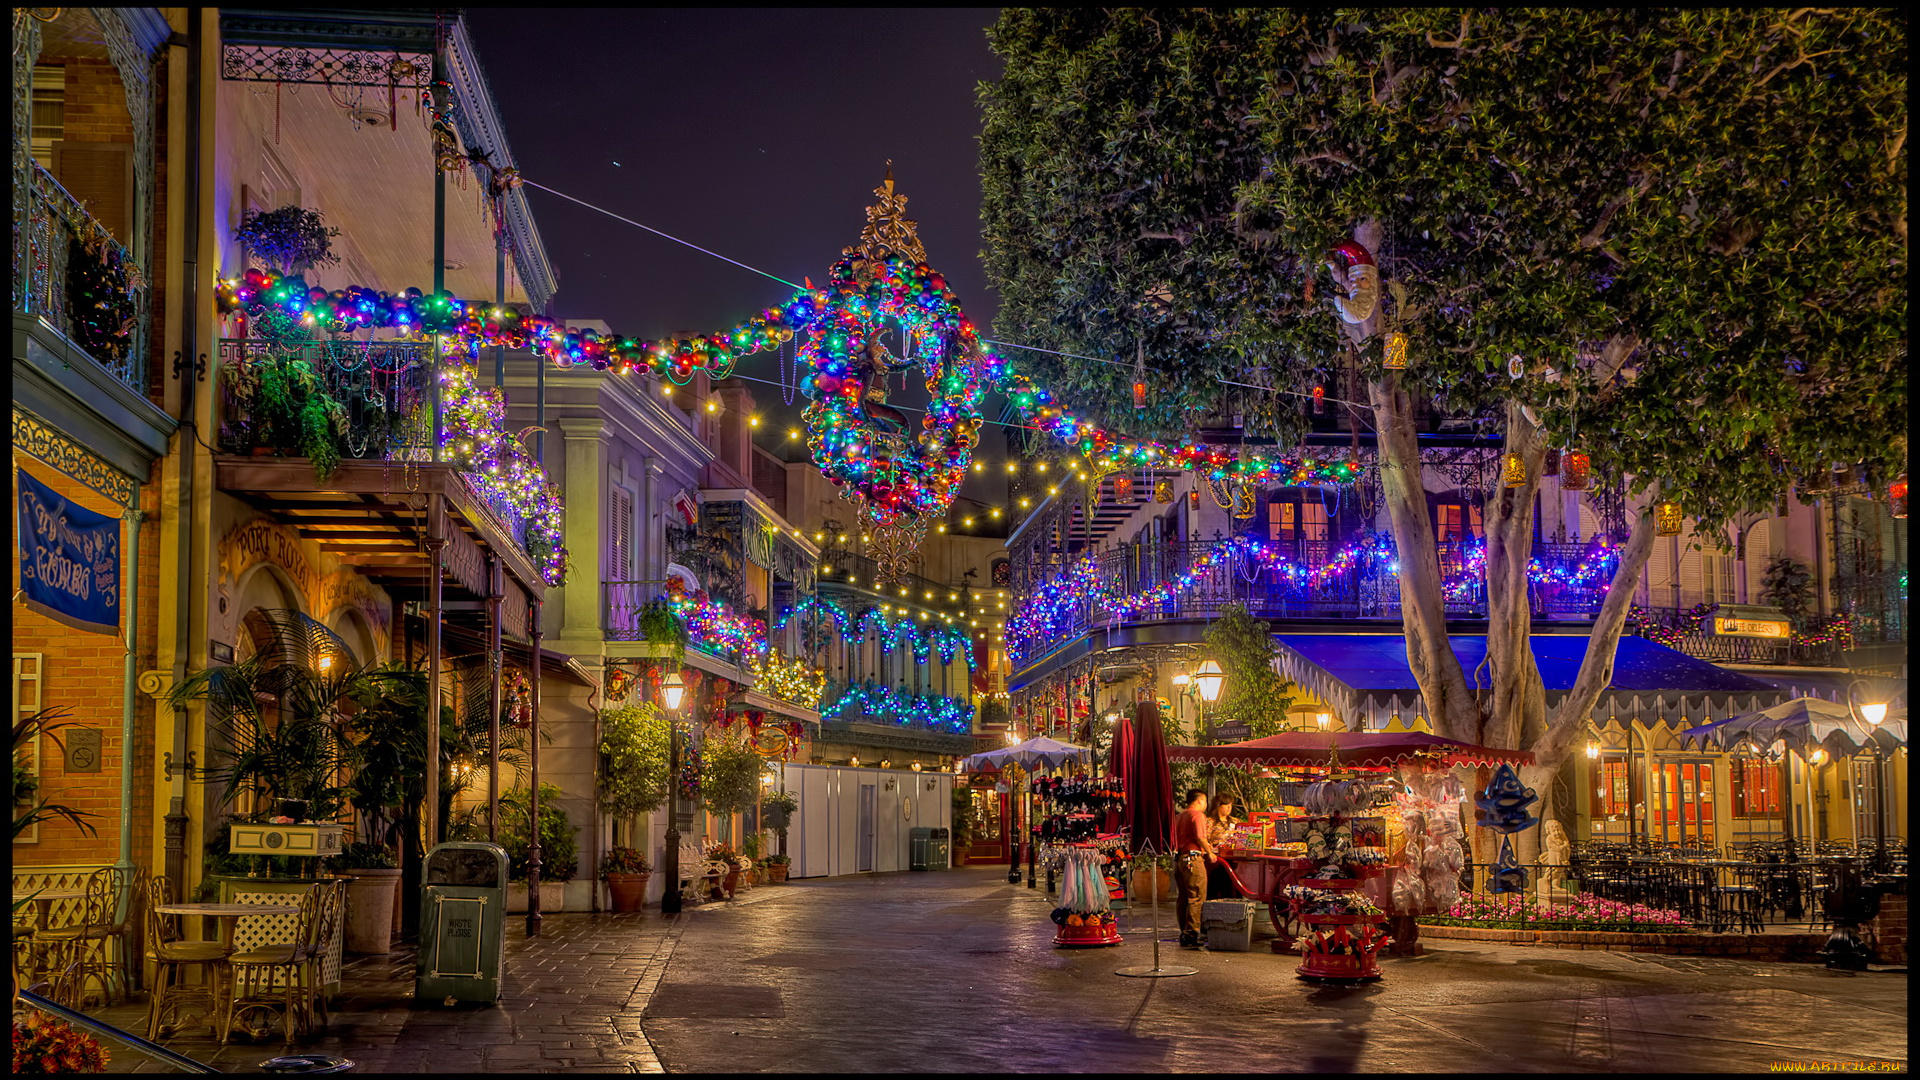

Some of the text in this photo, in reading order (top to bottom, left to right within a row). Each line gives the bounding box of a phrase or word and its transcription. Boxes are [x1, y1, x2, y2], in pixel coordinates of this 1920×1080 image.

[236, 525, 271, 566] PORT
[36, 545, 91, 600] GUMBO
[1217, 728, 1249, 736] ESPLANADE
[448, 919, 471, 928] WASTE
[447, 929, 471, 937] PLEASE
